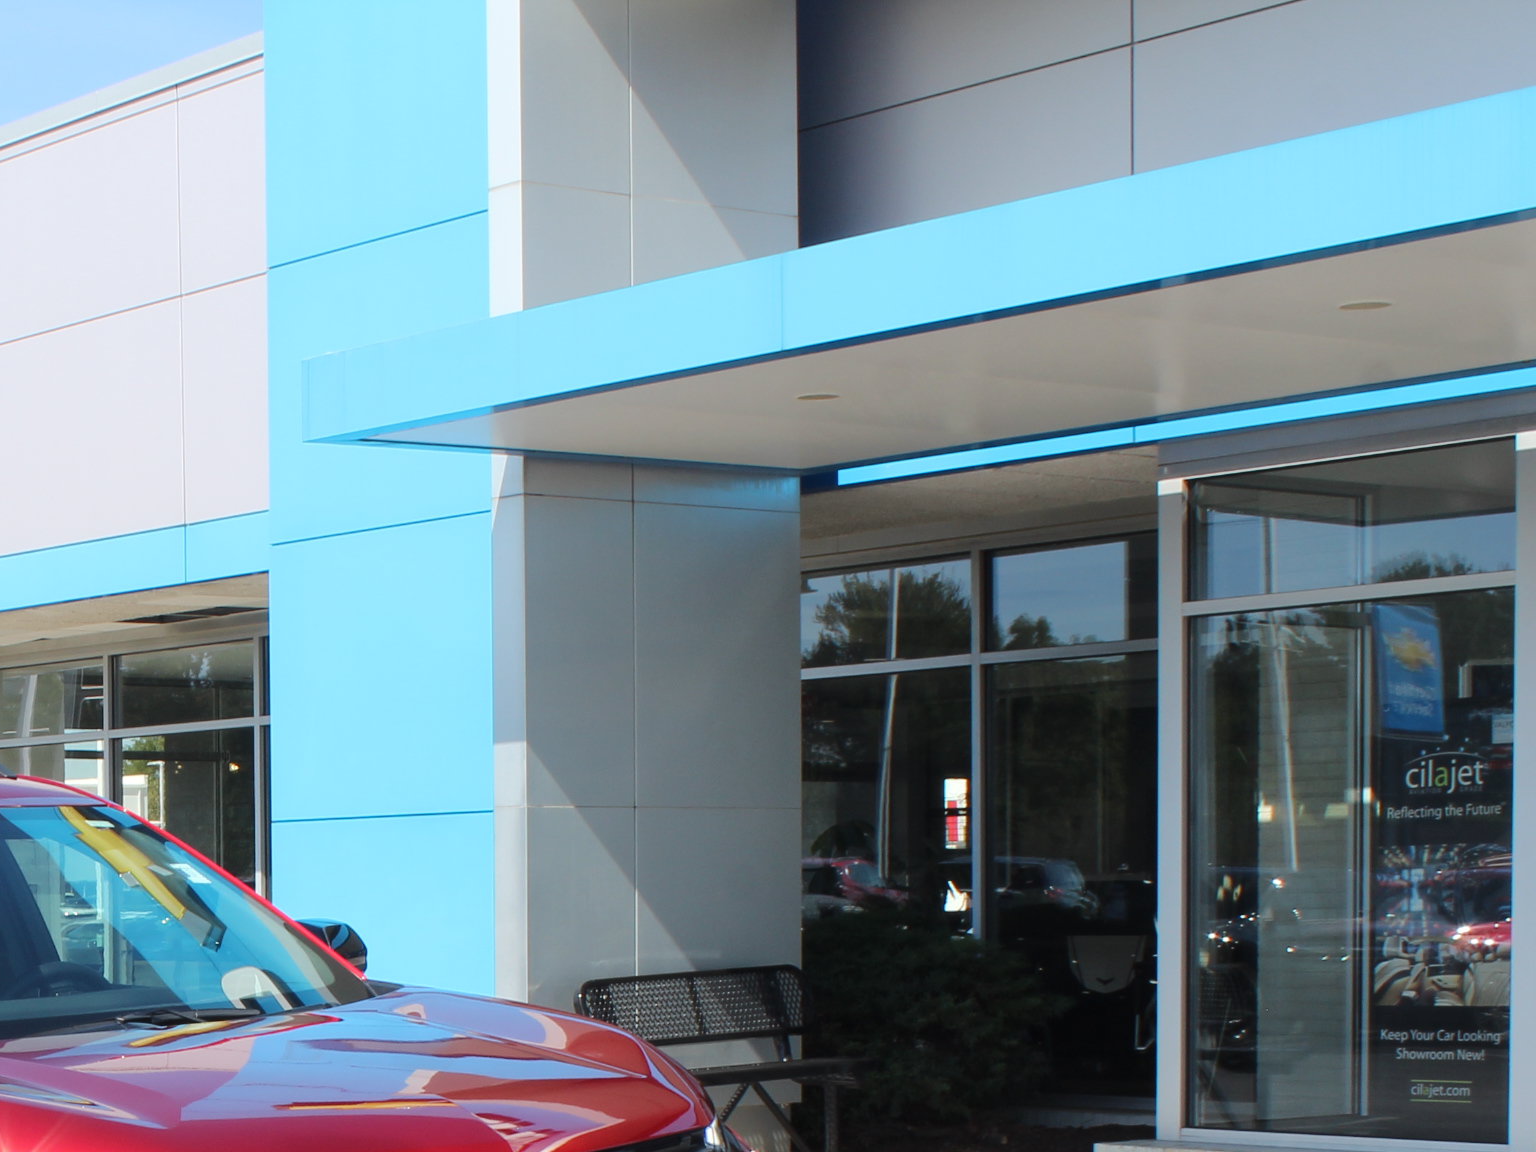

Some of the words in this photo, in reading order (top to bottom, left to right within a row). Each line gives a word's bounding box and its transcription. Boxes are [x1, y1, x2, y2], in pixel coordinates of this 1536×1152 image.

[1405, 759, 1484, 794] cilajet
[1386, 806, 1442, 820] Reflecting
[1444, 803, 1463, 816] the
[1465, 802, 1502, 815] Future
[1380, 1028, 1409, 1043] Keep
[1410, 1029, 1435, 1041] Your
[1436, 1029, 1454, 1041] Car
[1457, 1029, 1501, 1045] Looking
[1395, 1047, 1455, 1061] Showroom
[1456, 1048, 1486, 1062] New!
[1410, 1083, 1471, 1098] cilajet.com
